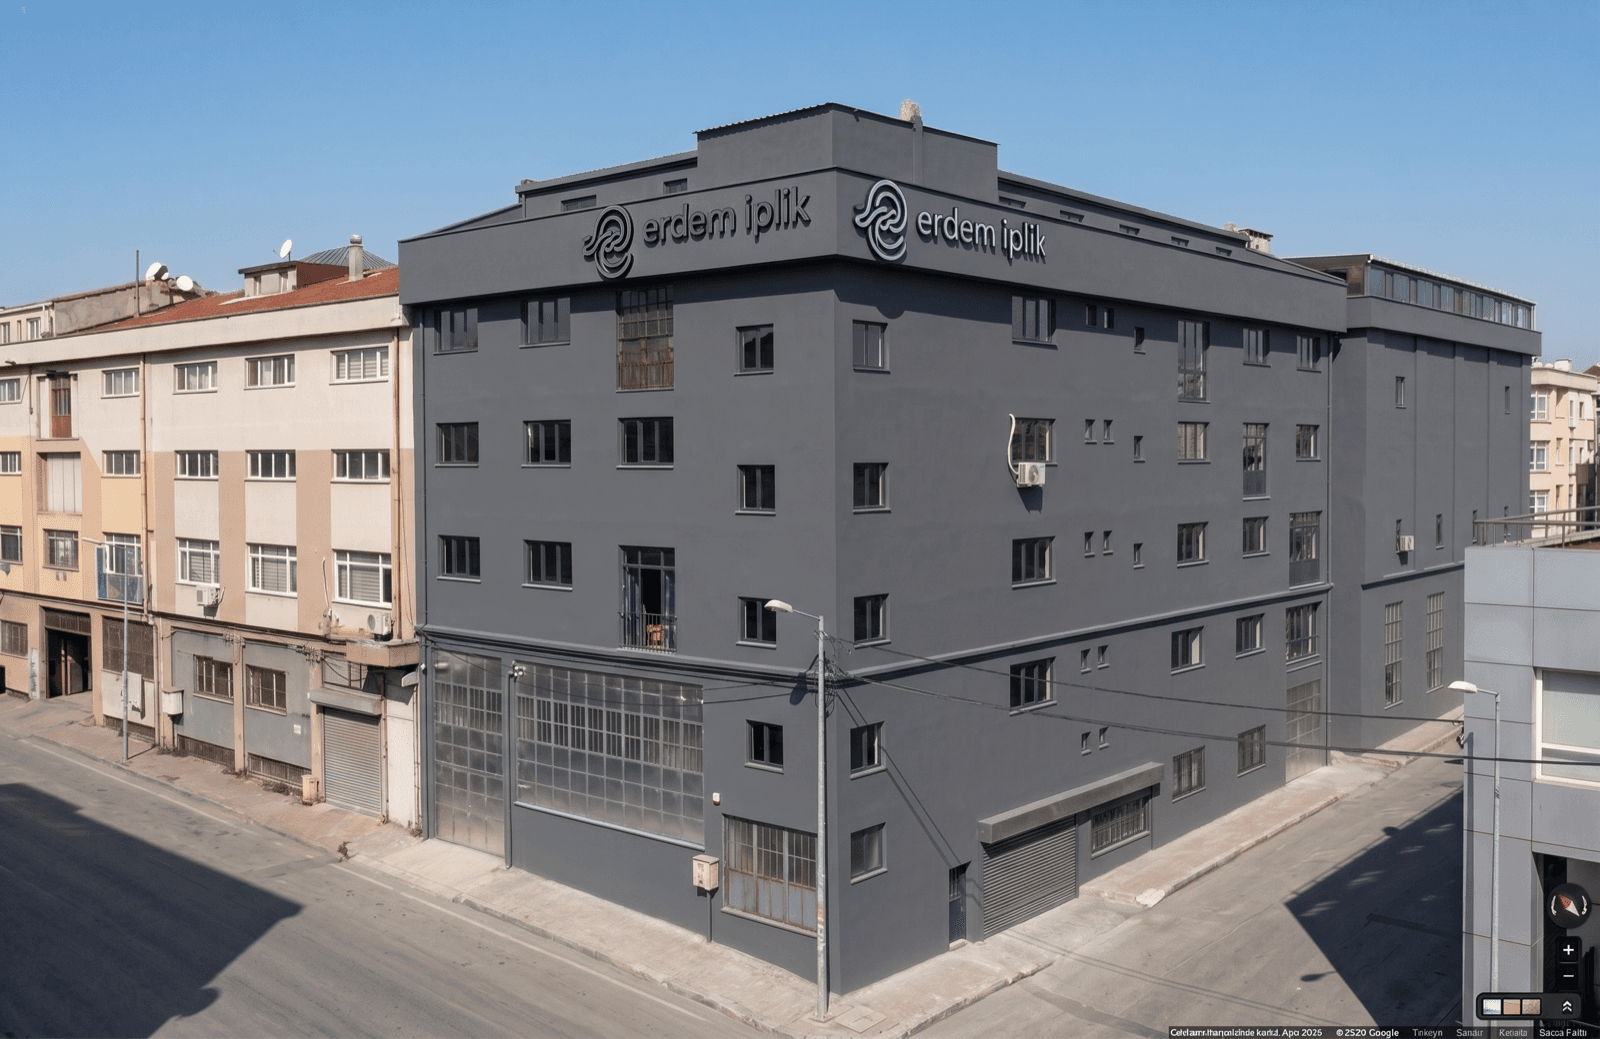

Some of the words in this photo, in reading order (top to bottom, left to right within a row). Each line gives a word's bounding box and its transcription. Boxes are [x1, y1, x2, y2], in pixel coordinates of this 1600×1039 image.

[642, 203, 735, 242] erdem
[745, 186, 811, 238] iplik
[917, 207, 995, 247] erdem
[1001, 218, 1046, 259] iplik
